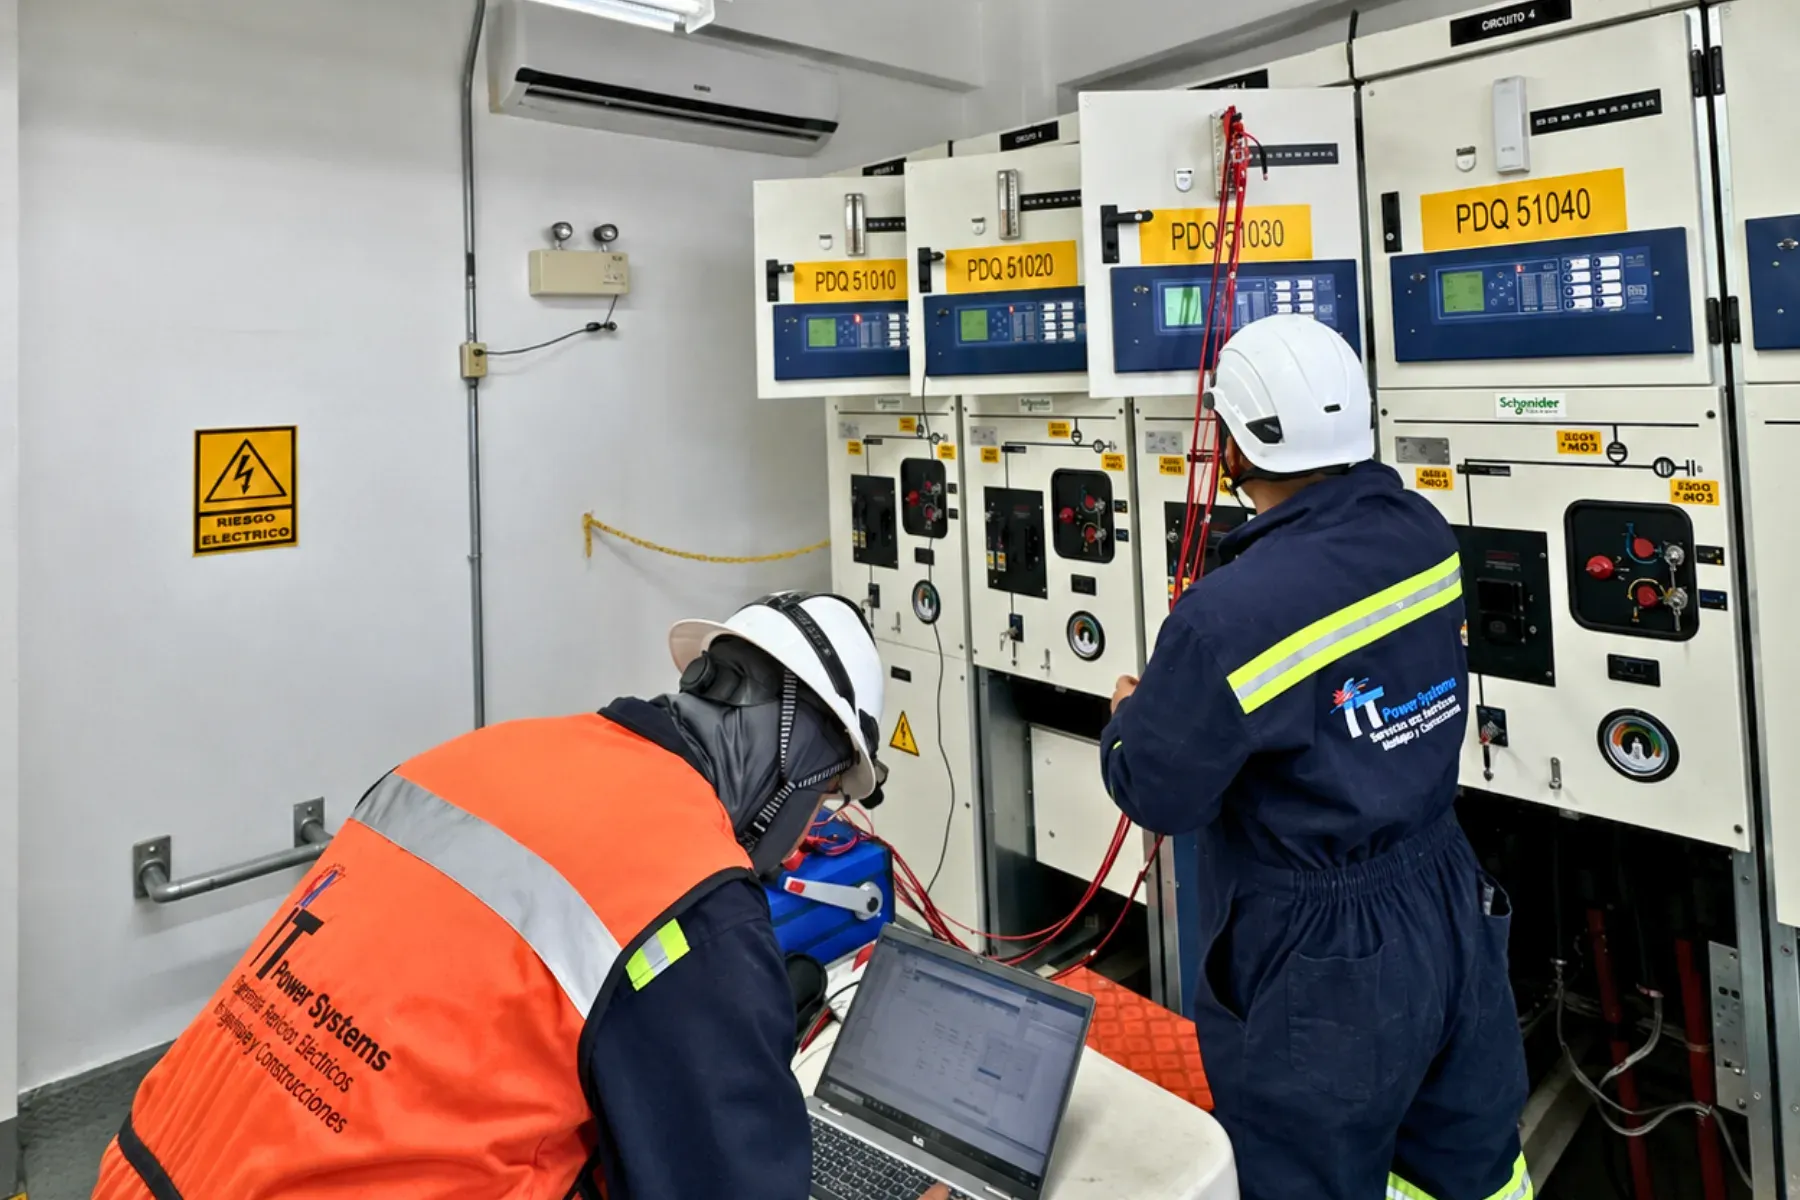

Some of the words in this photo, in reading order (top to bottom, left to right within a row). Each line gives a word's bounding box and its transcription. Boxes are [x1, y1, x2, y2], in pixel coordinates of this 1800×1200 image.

[1481, 11, 1526, 31] CIRCUITO
[1456, 200, 1510, 234] PDQ
[1516, 187, 1592, 228] 51040
[1171, 221, 1217, 250] PDQ
[1223, 218, 1285, 248] 51030
[967, 258, 1003, 282] PDQ
[1006, 252, 1055, 279] 51020
[815, 270, 849, 293] PDQ
[852, 269, 897, 290] 51010
[216, 513, 276, 528] RIESGO
[201, 527, 290, 546] ELECTRICO
[1382, 699, 1419, 723] Power
[270, 959, 314, 1007] Power
[307, 992, 392, 1072] Systems
[254, 1041, 348, 1135] Construcciones
